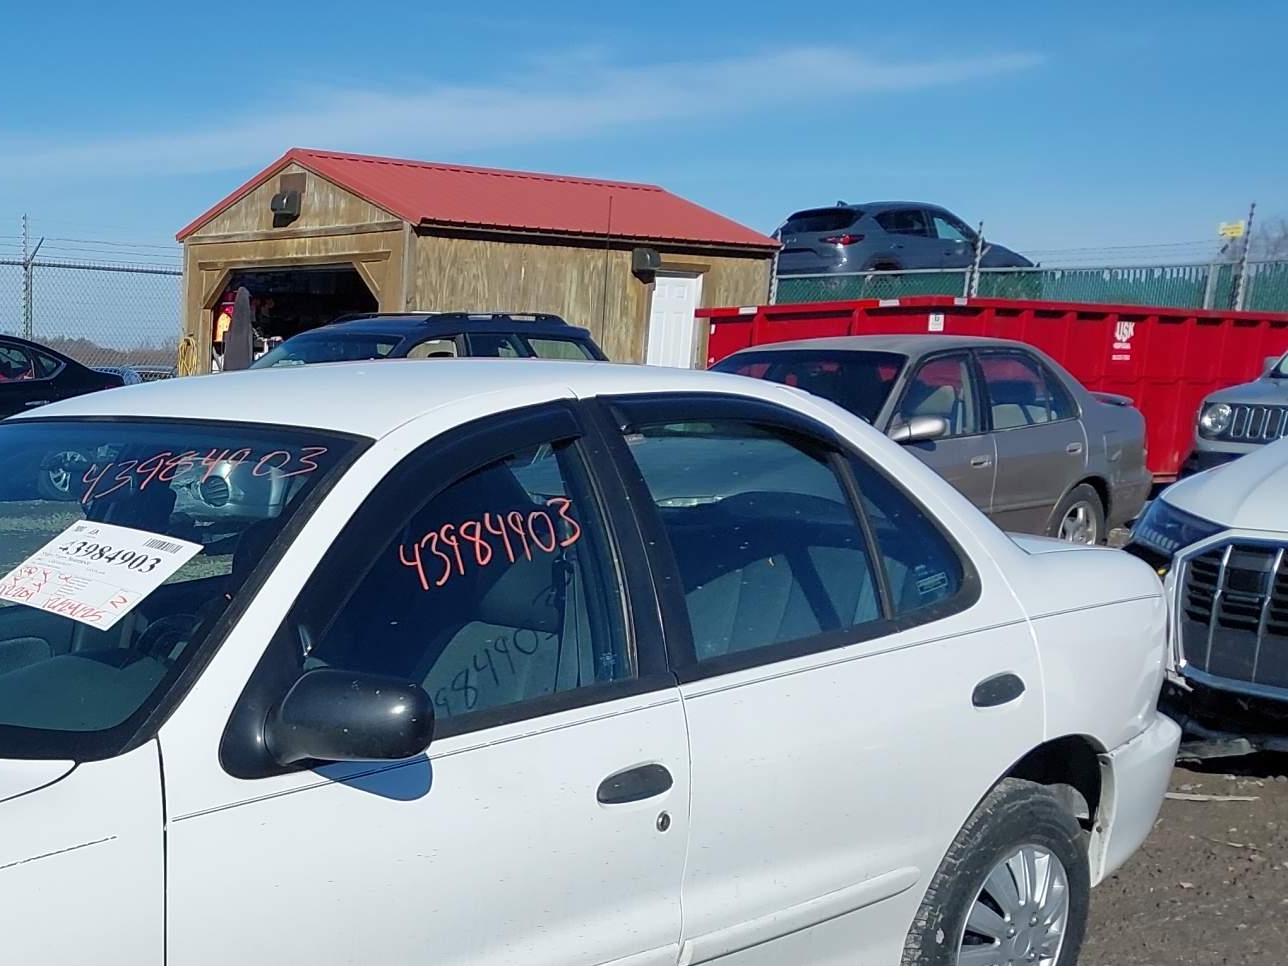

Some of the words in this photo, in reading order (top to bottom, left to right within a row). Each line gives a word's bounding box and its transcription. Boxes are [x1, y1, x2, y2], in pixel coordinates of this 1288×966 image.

[81, 446, 328, 504] 43984903
[58, 540, 162, 574] 43984903
[399, 497, 582, 591] 43984903
